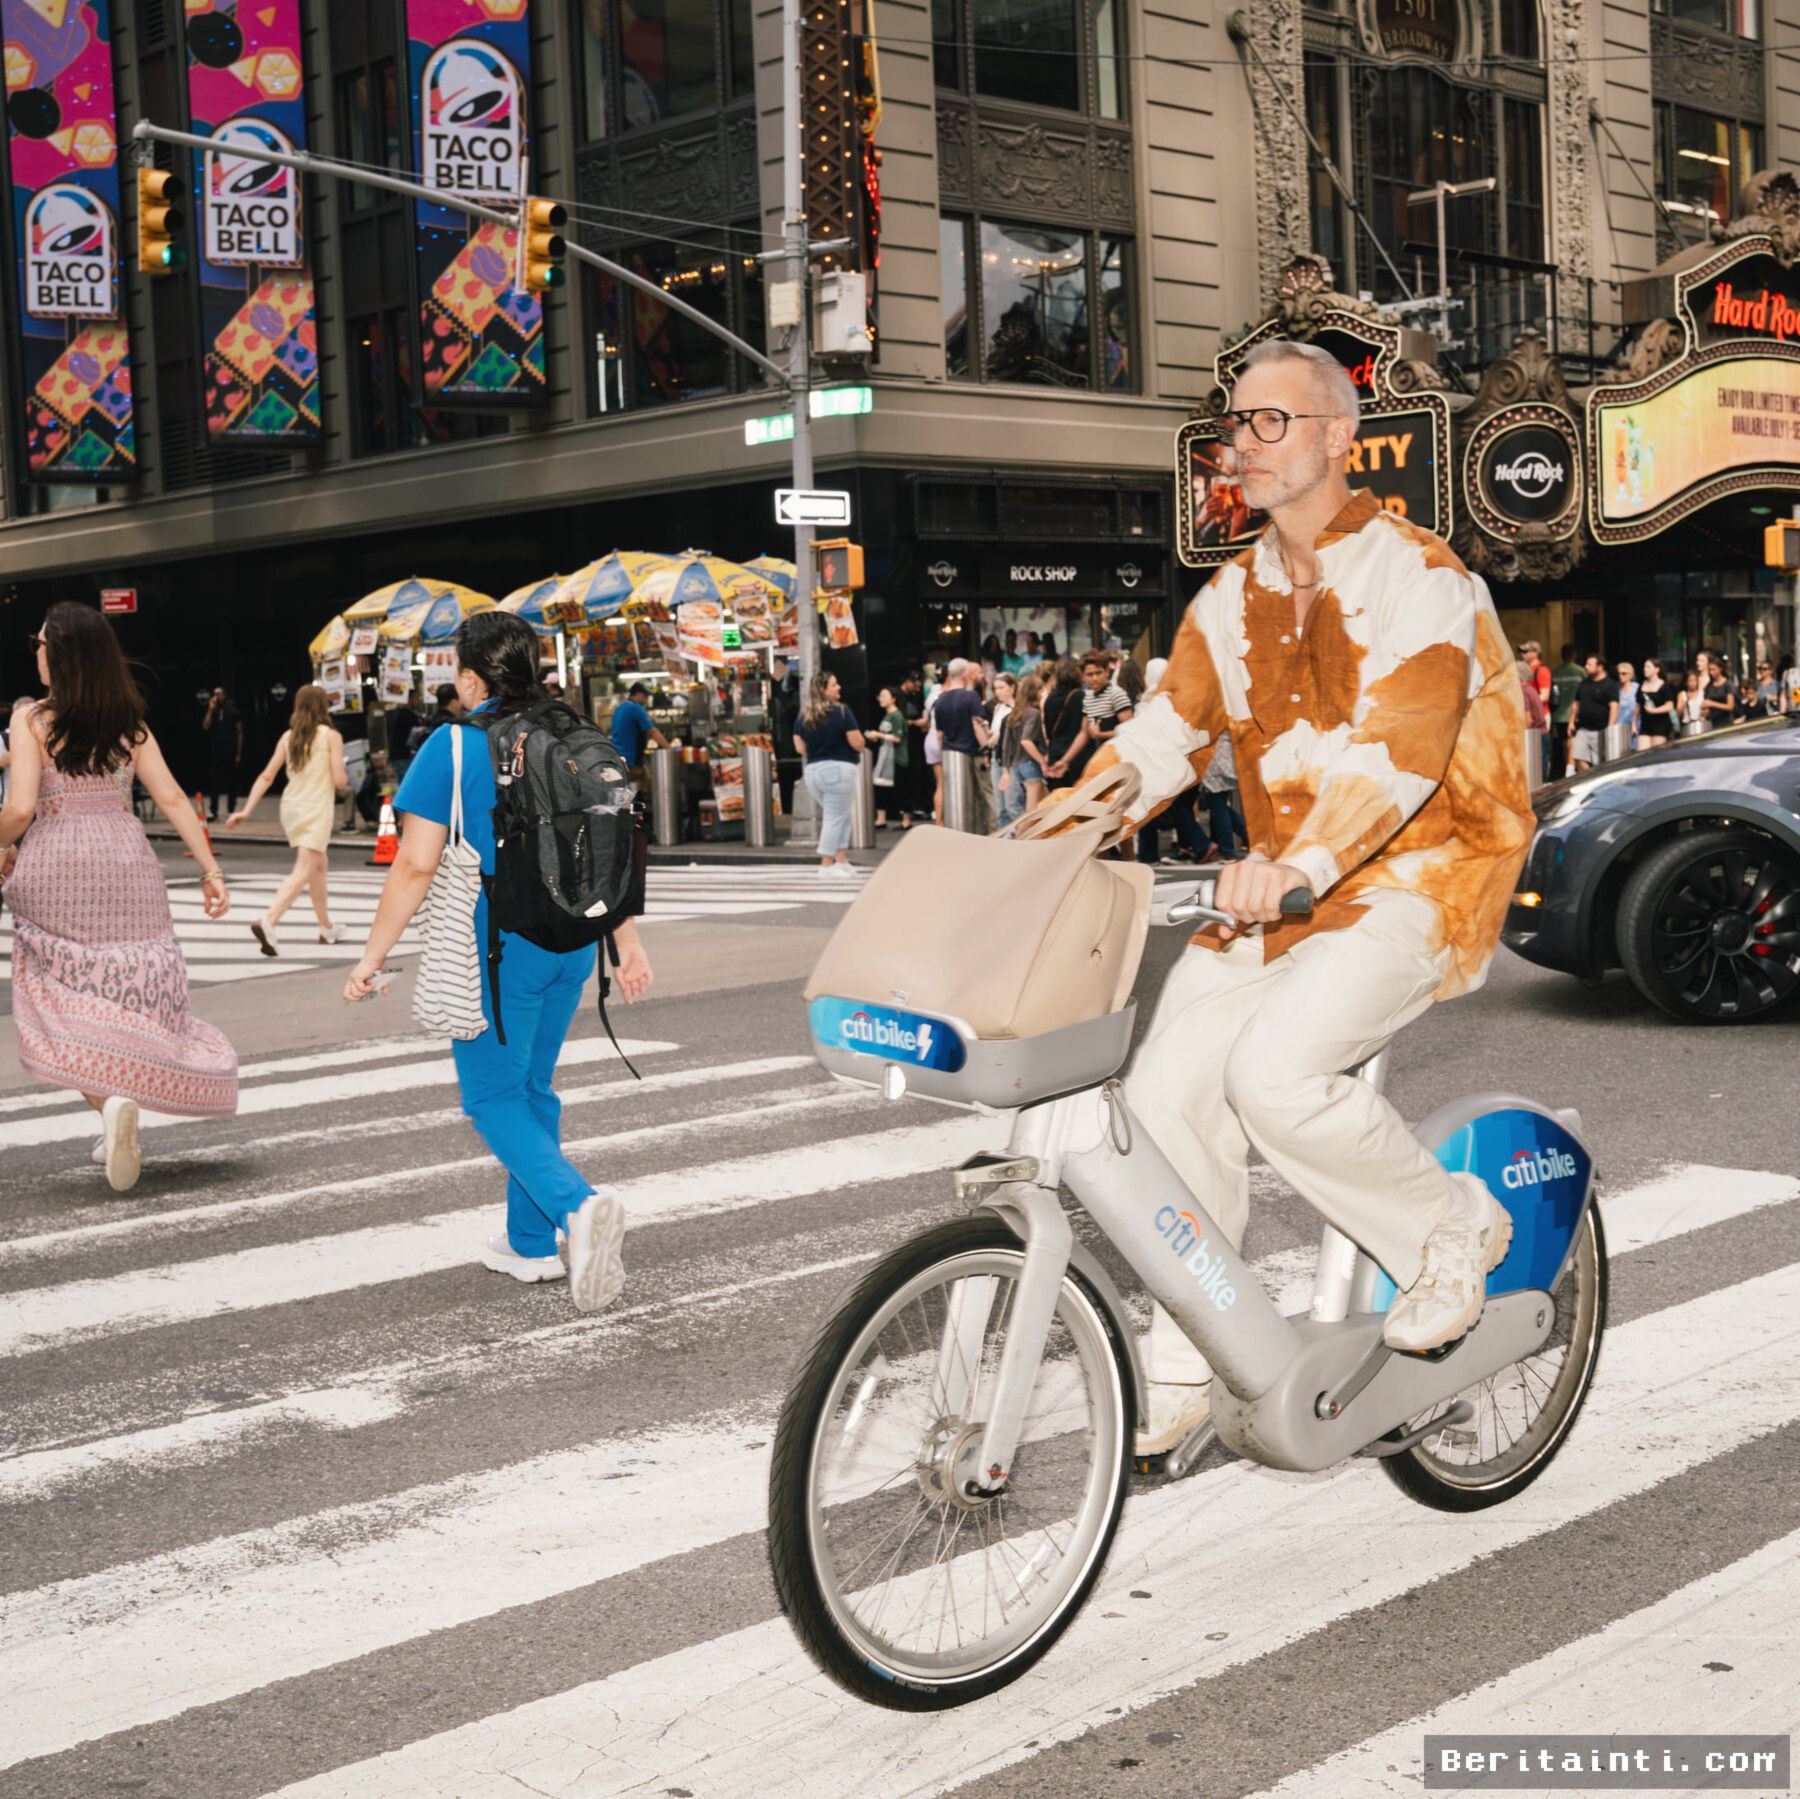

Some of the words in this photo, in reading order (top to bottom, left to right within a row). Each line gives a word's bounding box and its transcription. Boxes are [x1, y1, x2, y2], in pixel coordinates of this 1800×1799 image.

[1384, 29, 1448, 60] BROADWAY
[429, 133, 512, 163] TACO
[436, 163, 511, 192] BELL
[211, 203, 289, 228] TACO
[217, 229, 288, 254] BELL
[31, 261, 105, 283] TACO
[38, 285, 104, 307] BELL
[1714, 282, 1769, 330] Hard
[1344, 433, 1413, 474] RTY
[1494, 463, 1533, 481] Hard
[1533, 462, 1564, 482] Rock
[1010, 566, 1043, 581] ROCK
[1044, 566, 1077, 581] SHOP
[841, 1014, 873, 1042] citi
[875, 1017, 916, 1051] bike
[1502, 1152, 1538, 1189] citi
[1536, 1148, 1576, 1182] bike
[1154, 1205, 1200, 1258] citi
[1185, 1238, 1237, 1312] bike
